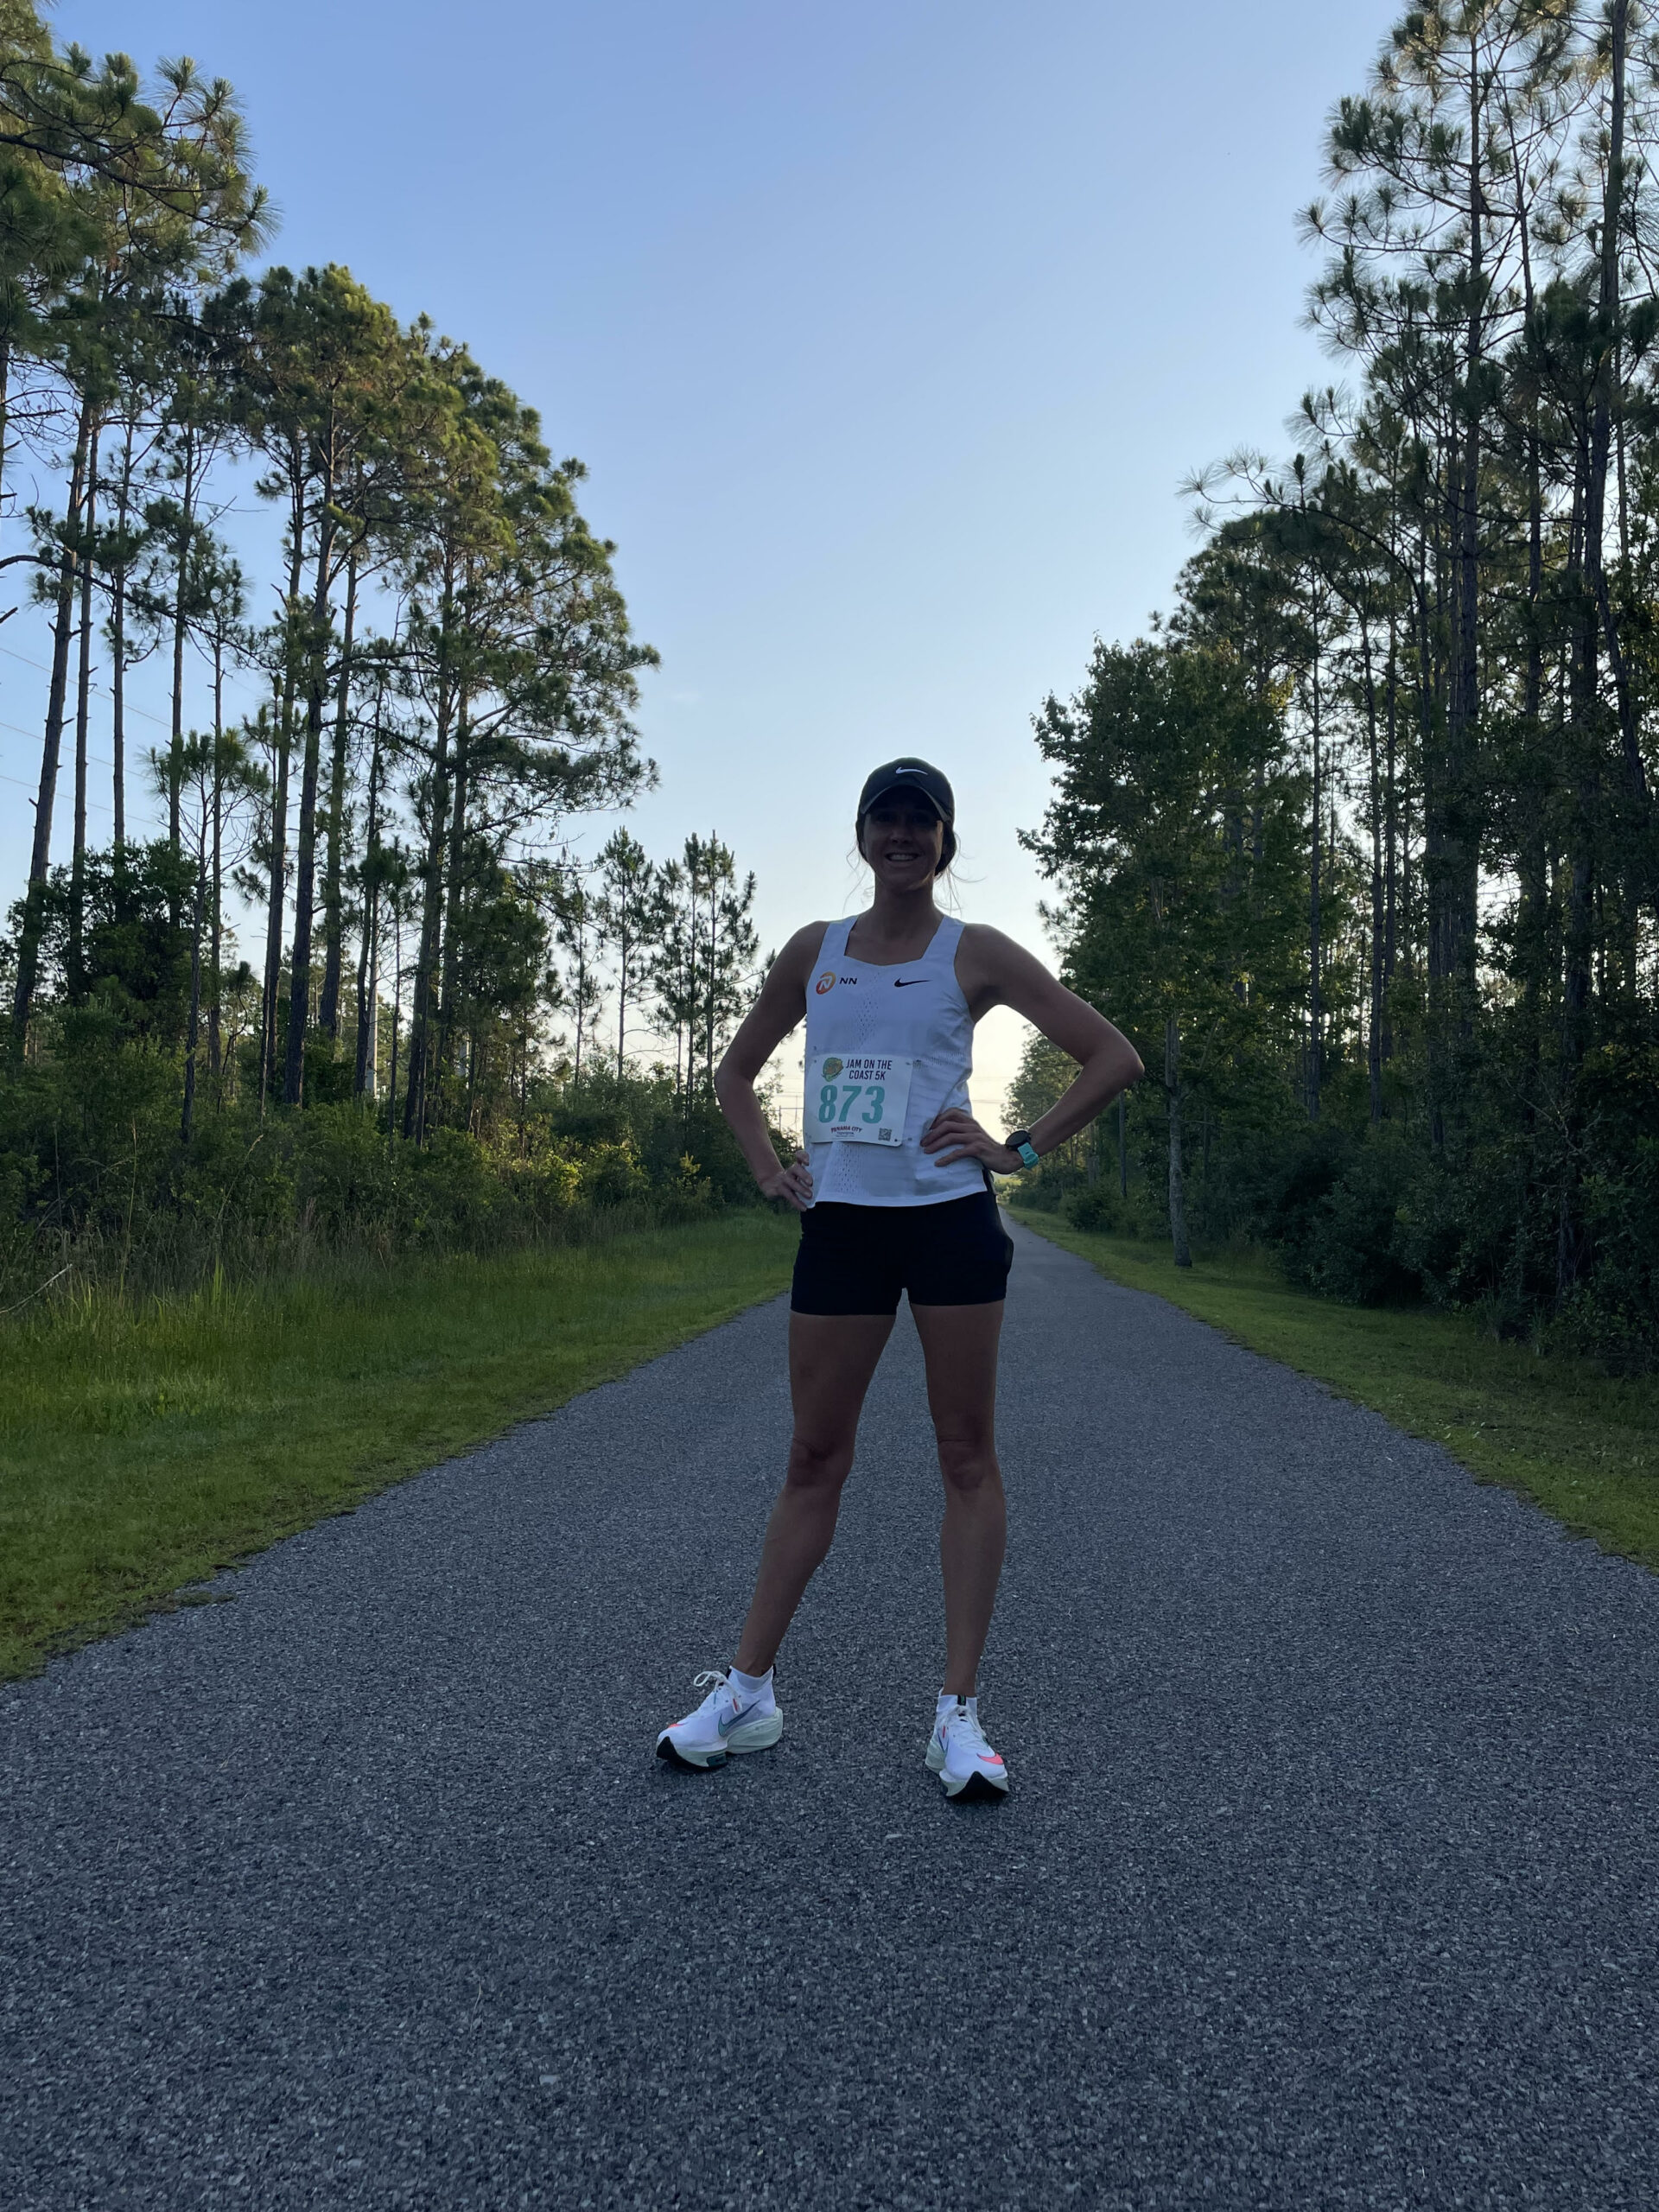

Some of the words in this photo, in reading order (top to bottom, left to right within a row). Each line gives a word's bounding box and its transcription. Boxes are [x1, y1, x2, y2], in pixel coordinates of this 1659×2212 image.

[846, 1059, 861, 1069] JAM
[864, 1059, 874, 1069] ON
[877, 1059, 893, 1071] THE
[849, 1070, 874, 1080] COAST
[874, 1071, 887, 1081] 5K
[818, 1084, 885, 1124] 873
[830, 1125, 850, 1134] PANAMA
